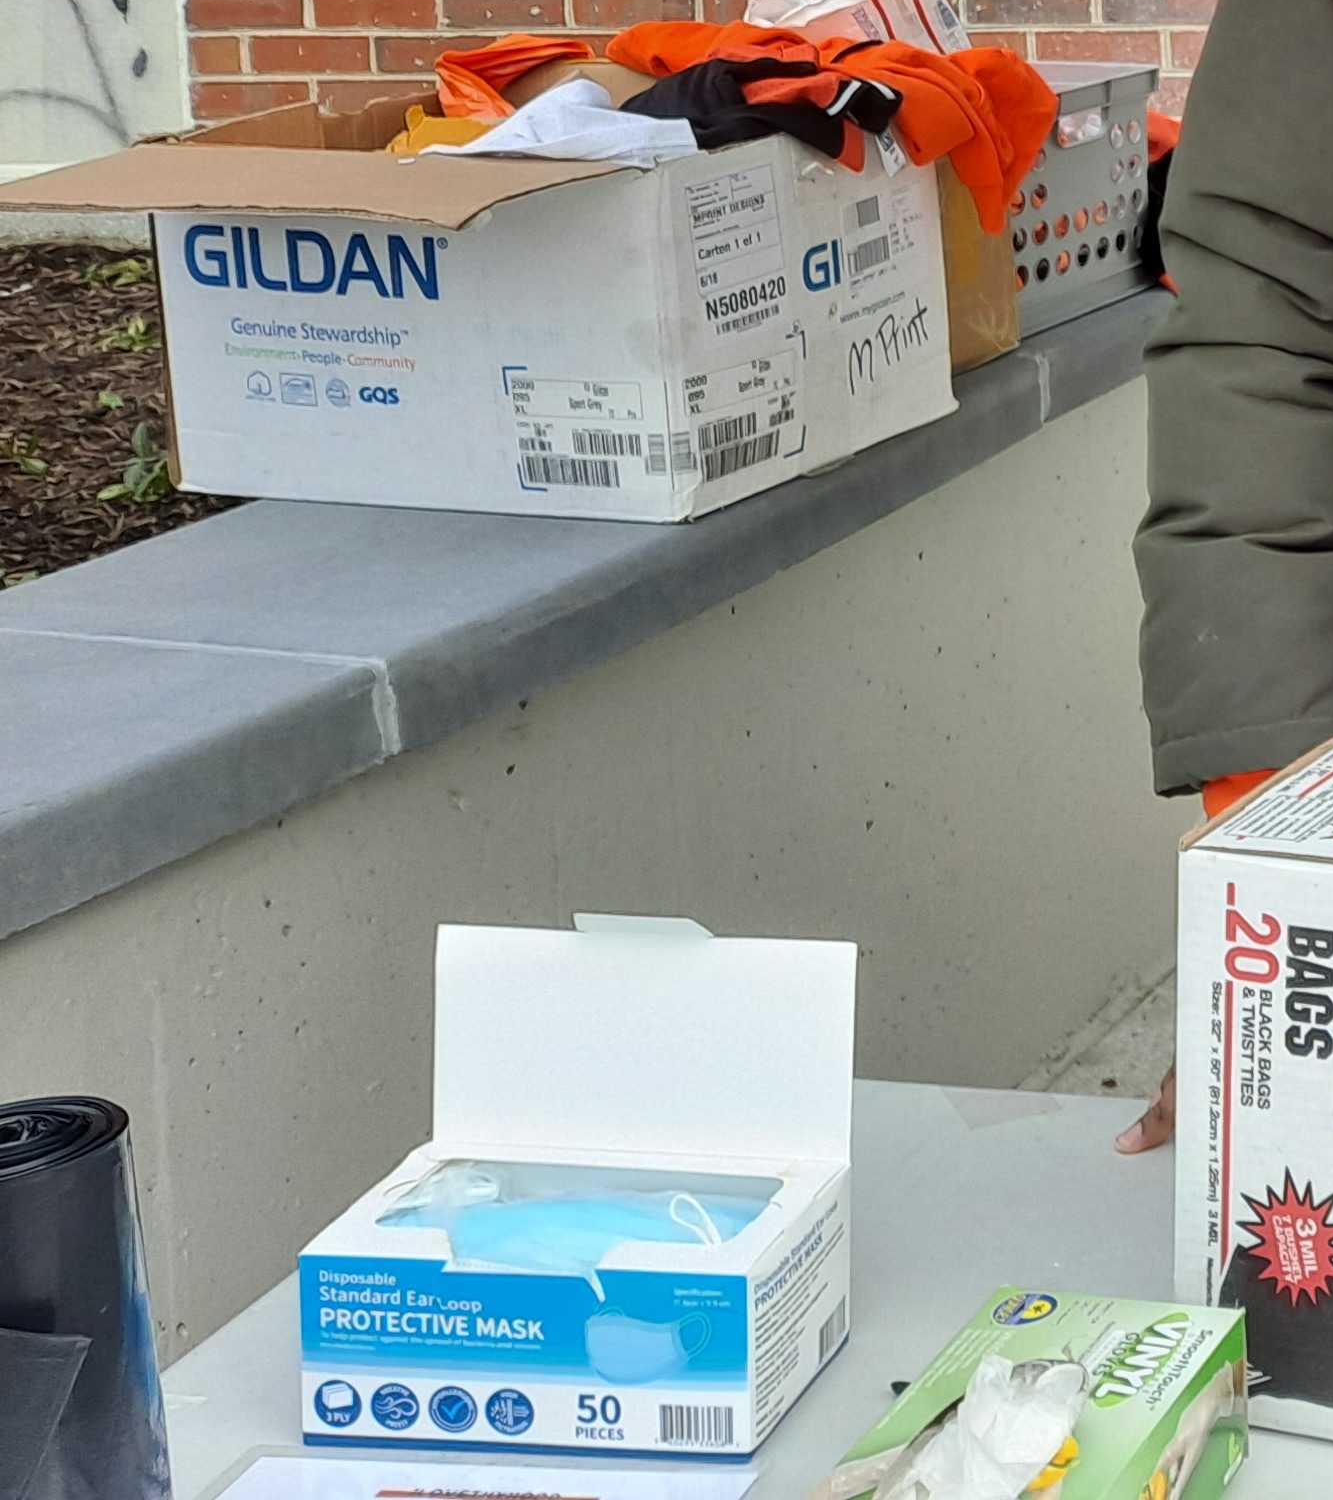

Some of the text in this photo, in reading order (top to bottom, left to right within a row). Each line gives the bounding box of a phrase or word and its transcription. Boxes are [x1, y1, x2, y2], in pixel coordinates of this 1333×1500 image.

[705, 276, 787, 322] N5080420
[231, 317, 297, 339] Genuine
[1224, 909, 1281, 984] 20
[1240, 987, 1255, 1107] & TWIST TIES
[1257, 989, 1273, 1110] BLACK BAGS
[1296, 1218, 1318, 1279] 3 MIL
[319, 1269, 396, 1286] Disposable
[319, 1286, 401, 1306] Standard
[406, 1290, 434, 1307] Ear
[319, 1307, 545, 1341] PROTECTIVE MASK
[1096, 1321, 1193, 1398] VINYL
[577, 1394, 621, 1424] 50
[575, 1427, 625, 1441] PIECES
